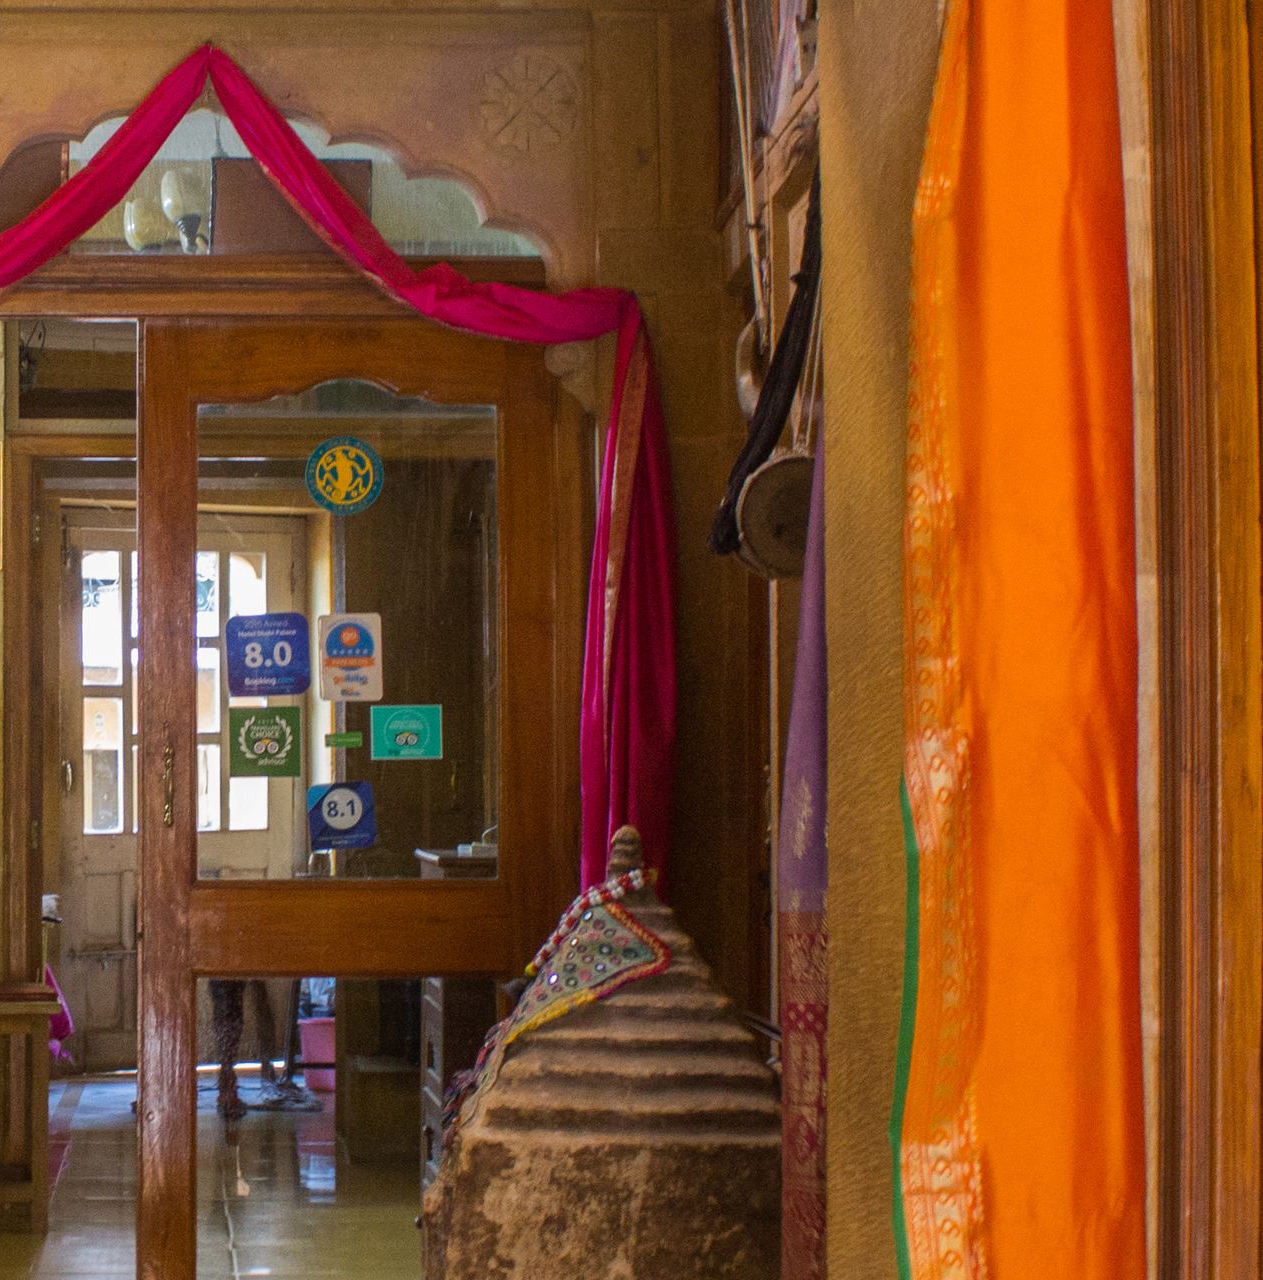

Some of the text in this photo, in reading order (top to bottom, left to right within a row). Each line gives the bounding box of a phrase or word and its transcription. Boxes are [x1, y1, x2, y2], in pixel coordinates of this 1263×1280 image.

[244, 640, 292, 668] 8.0
[249, 729, 280, 739] CHOICE
[327, 799, 356, 818] 8.1
